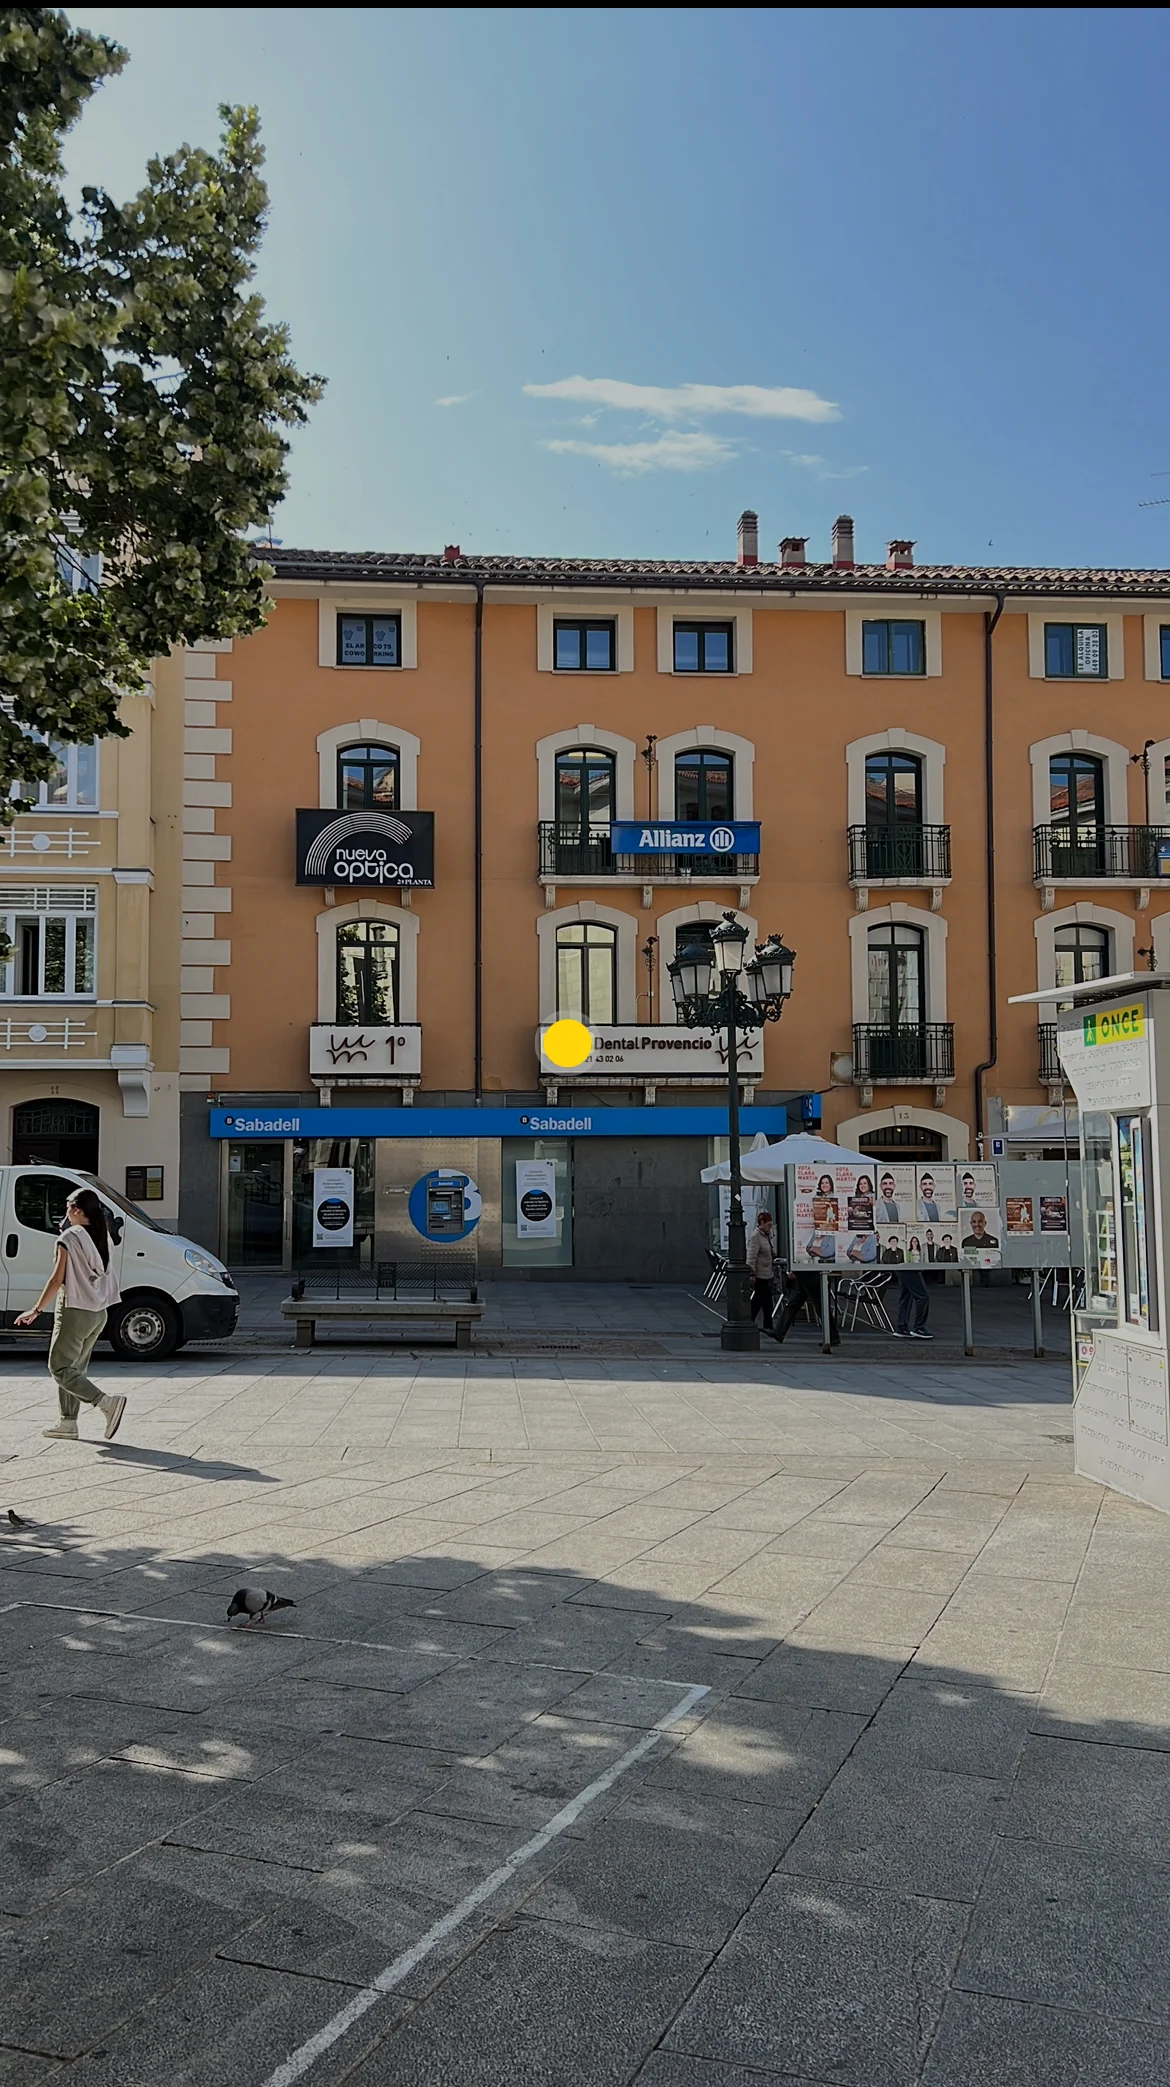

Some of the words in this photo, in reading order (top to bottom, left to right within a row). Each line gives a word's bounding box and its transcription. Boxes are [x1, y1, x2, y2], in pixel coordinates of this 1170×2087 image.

[638, 829, 706, 848] Allianz
[335, 848, 387, 861] nueva
[333, 860, 414, 884] optica
[1101, 1009, 1140, 1038] ONCE
[594, 1036, 640, 1050] Dental
[641, 1036, 713, 1050] Provencio
[605, 1055, 614, 1063] 02
[615, 1055, 624, 1063] 06
[234, 1117, 300, 1132] Sabadell
[529, 1116, 592, 1131] Sabadell
